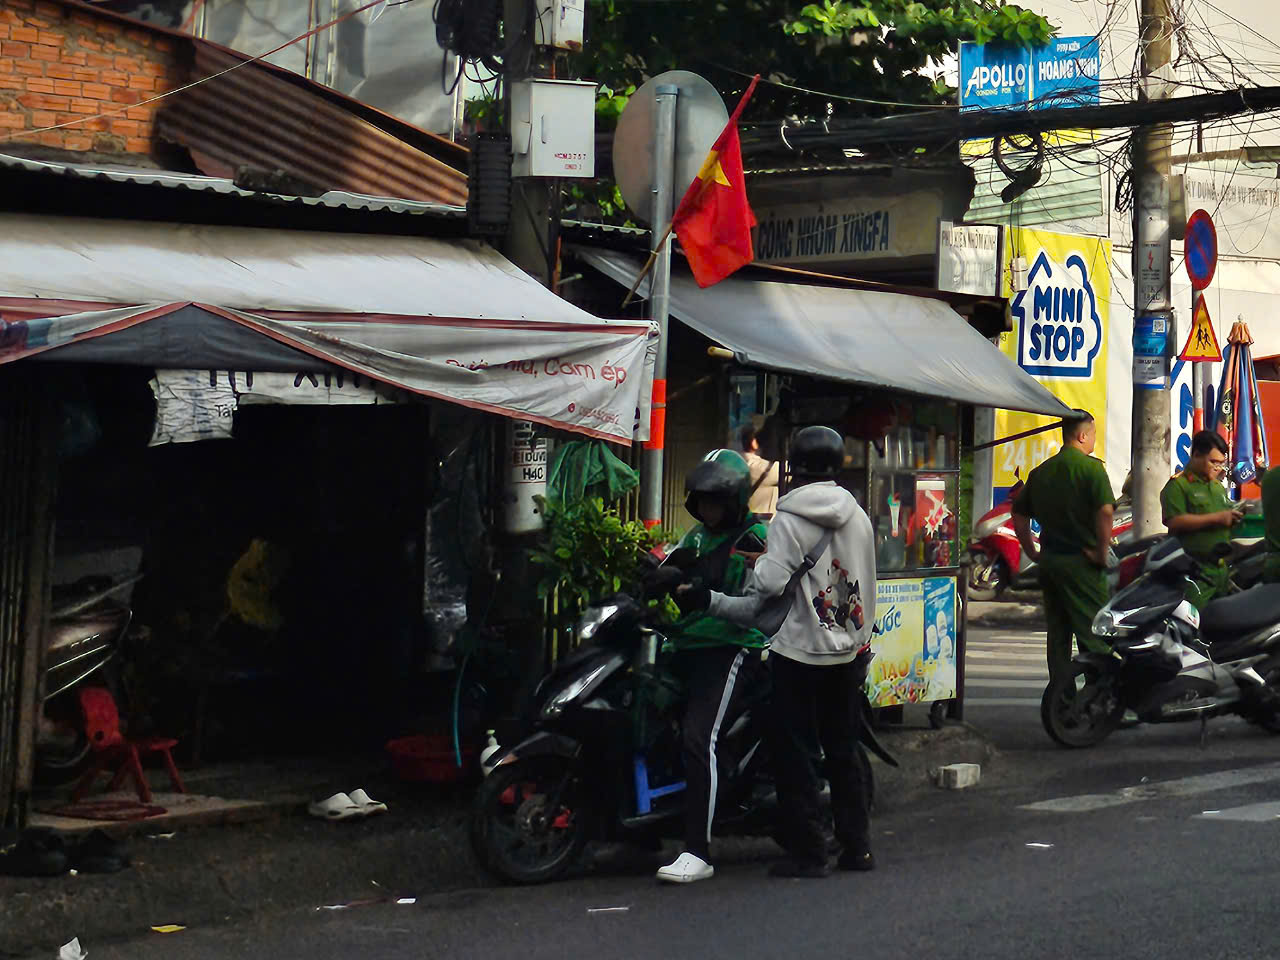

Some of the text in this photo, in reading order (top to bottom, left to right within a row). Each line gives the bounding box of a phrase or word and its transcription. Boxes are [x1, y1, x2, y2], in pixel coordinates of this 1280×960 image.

[964, 64, 1026, 98] APOLLO
[1039, 56, 1073, 80] HOÀNG
[758, 204, 888, 259] CÔNG NHÔM XINGFA
[1033, 285, 1083, 323] MINI
[1029, 323, 1084, 361] STOP
[544, 359, 595, 380] Cam
[601, 359, 627, 389] ép
[1003, 440, 1027, 472] 24
